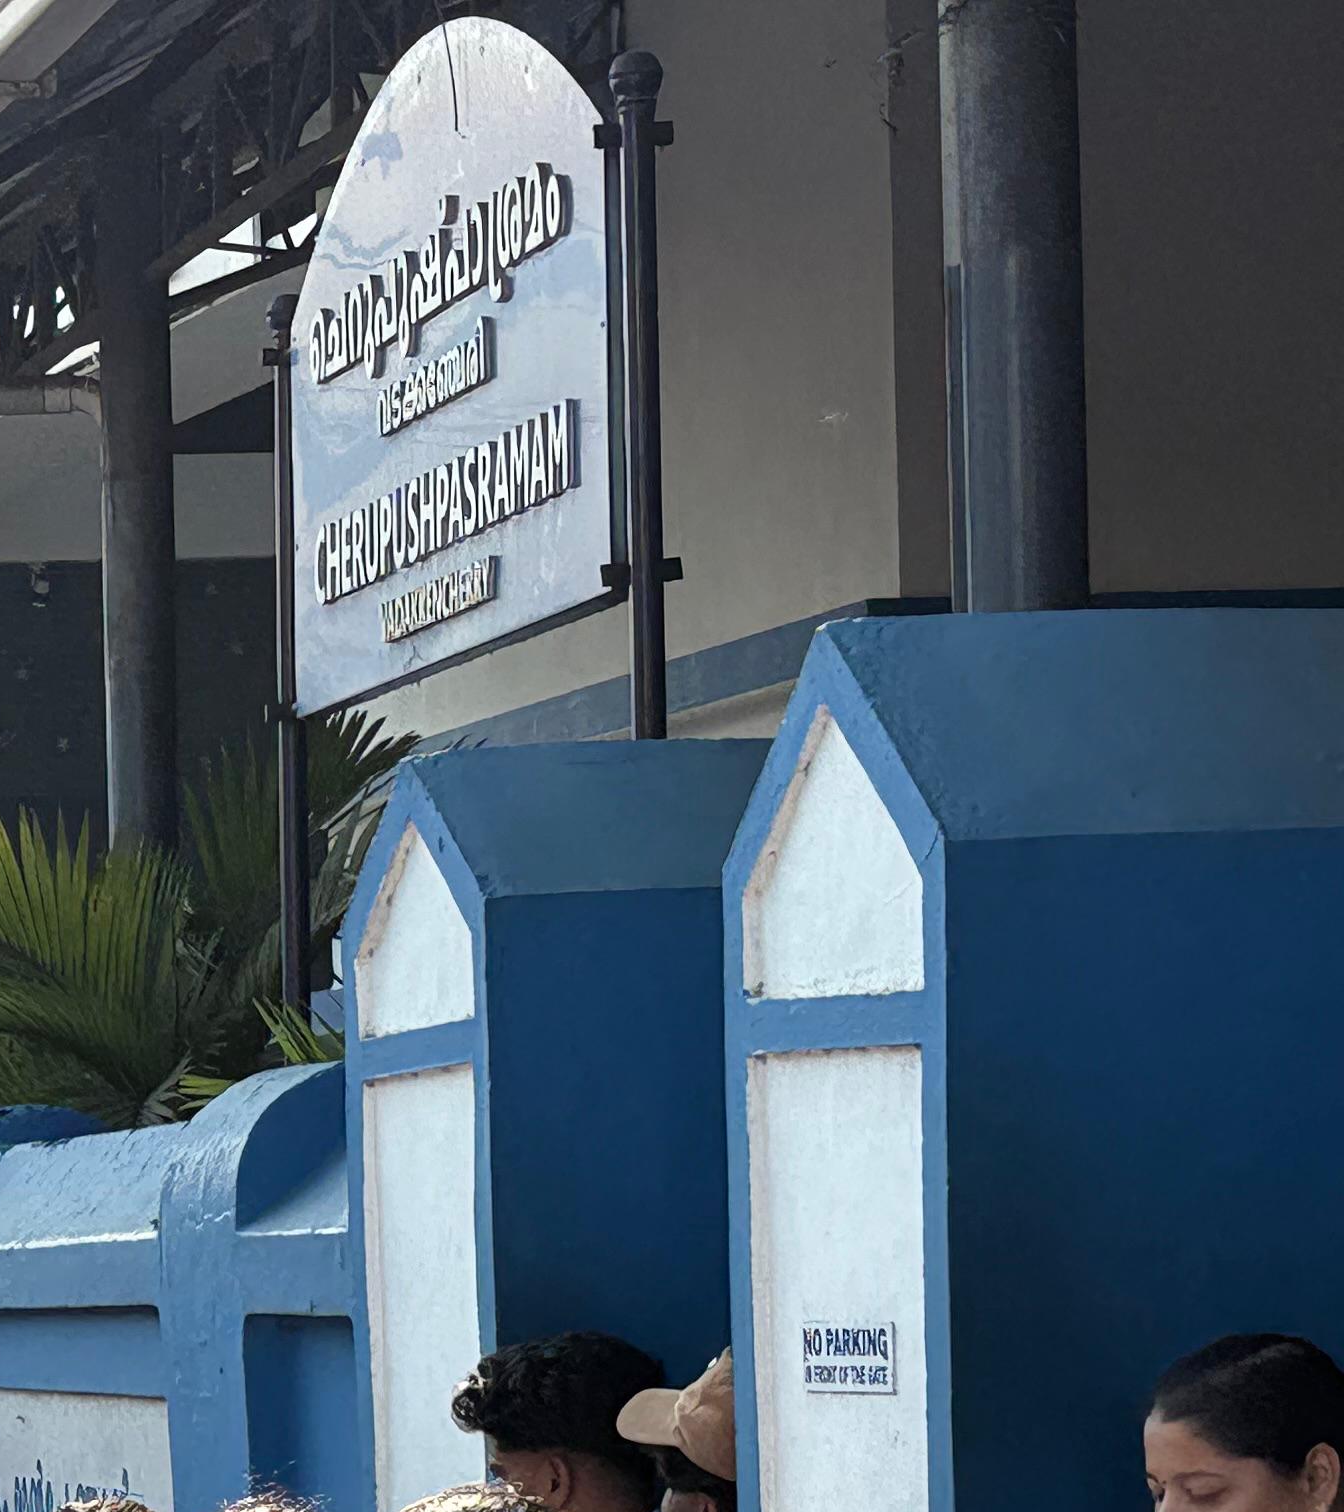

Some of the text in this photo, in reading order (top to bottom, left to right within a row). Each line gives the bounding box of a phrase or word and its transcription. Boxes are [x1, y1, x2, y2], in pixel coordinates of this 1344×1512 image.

[314, 399, 576, 602] CHERUPUSHPASRAMAM
[803, 1328, 888, 1360] NO PARKING
